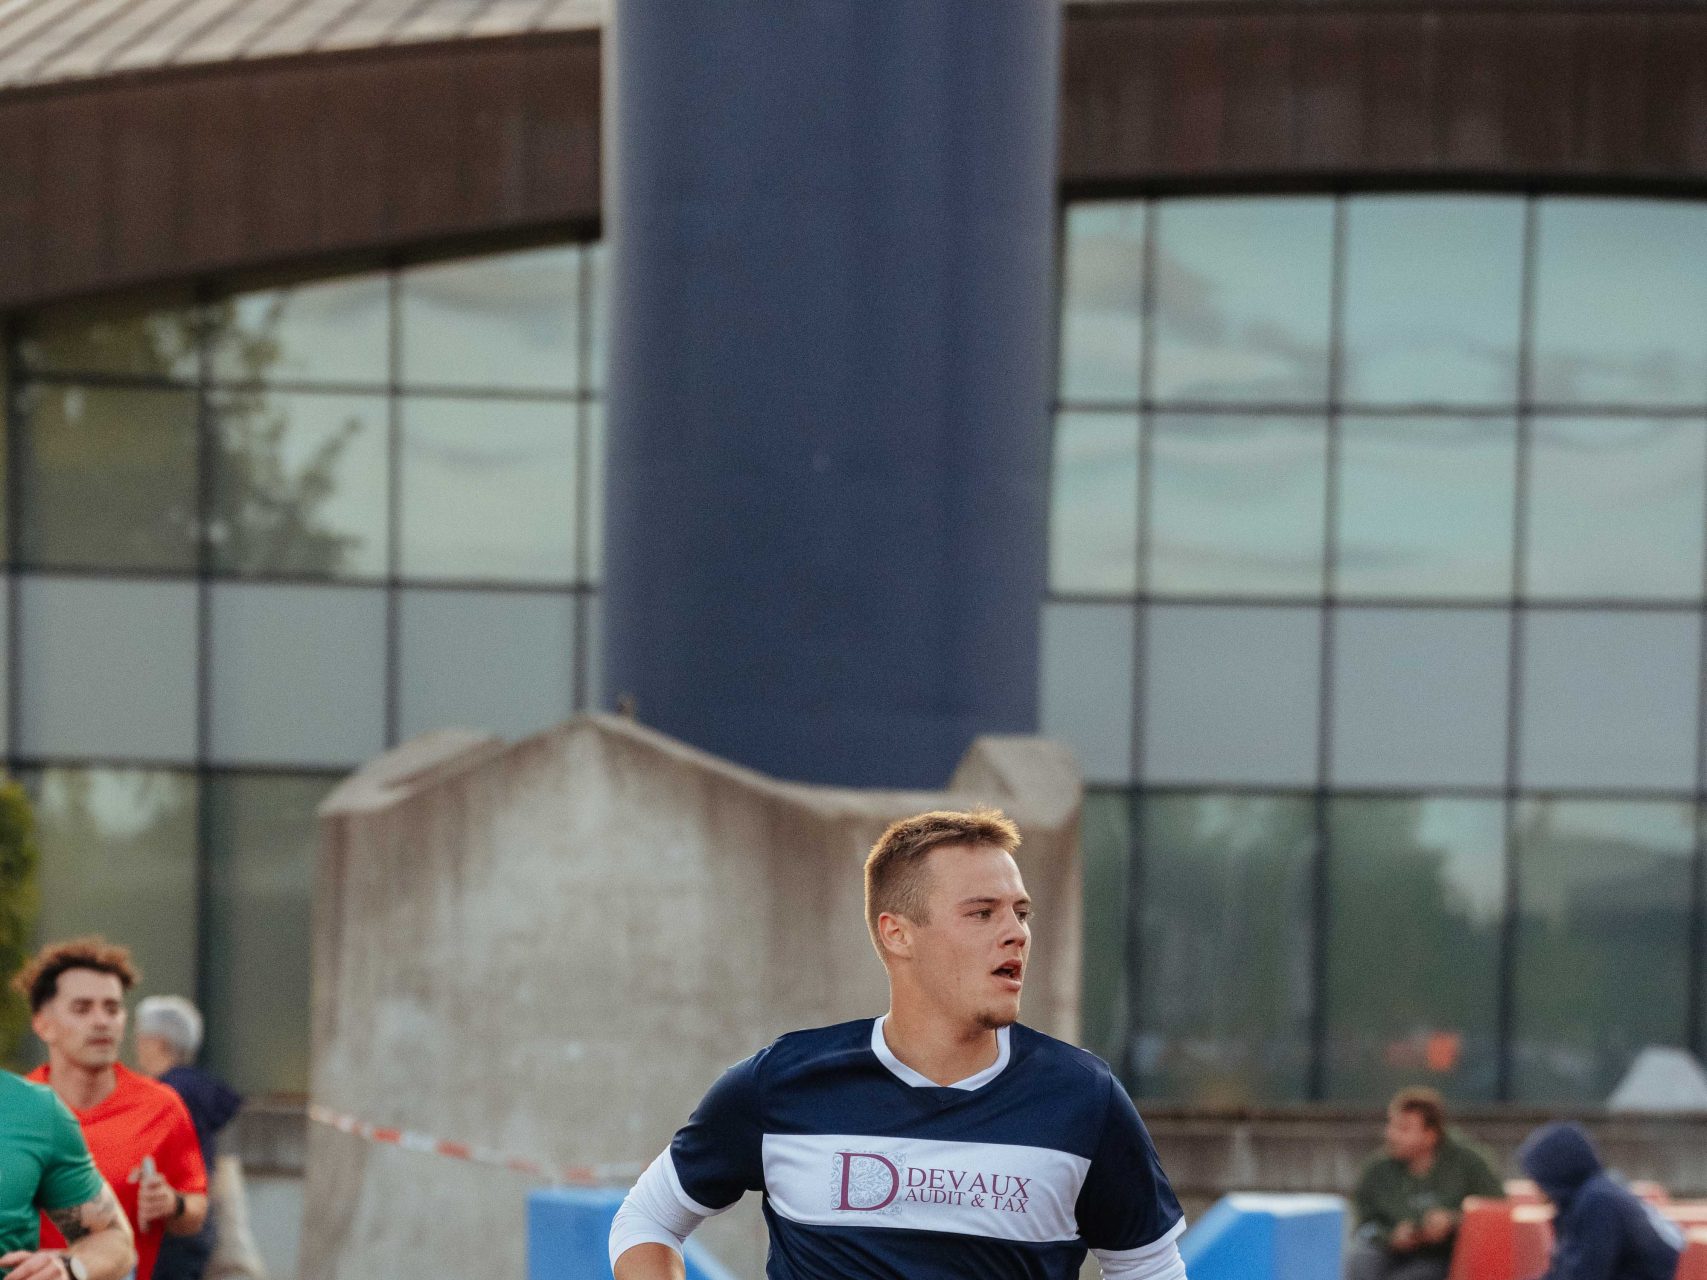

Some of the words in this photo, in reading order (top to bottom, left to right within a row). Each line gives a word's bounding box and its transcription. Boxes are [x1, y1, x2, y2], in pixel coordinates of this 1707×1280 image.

[832, 1152, 900, 1211] D
[906, 1167, 1031, 1199] DEVAUX
[905, 1188, 965, 1206] AUDIT
[970, 1193, 985, 1208] &
[991, 1196, 1028, 1213] TAX
